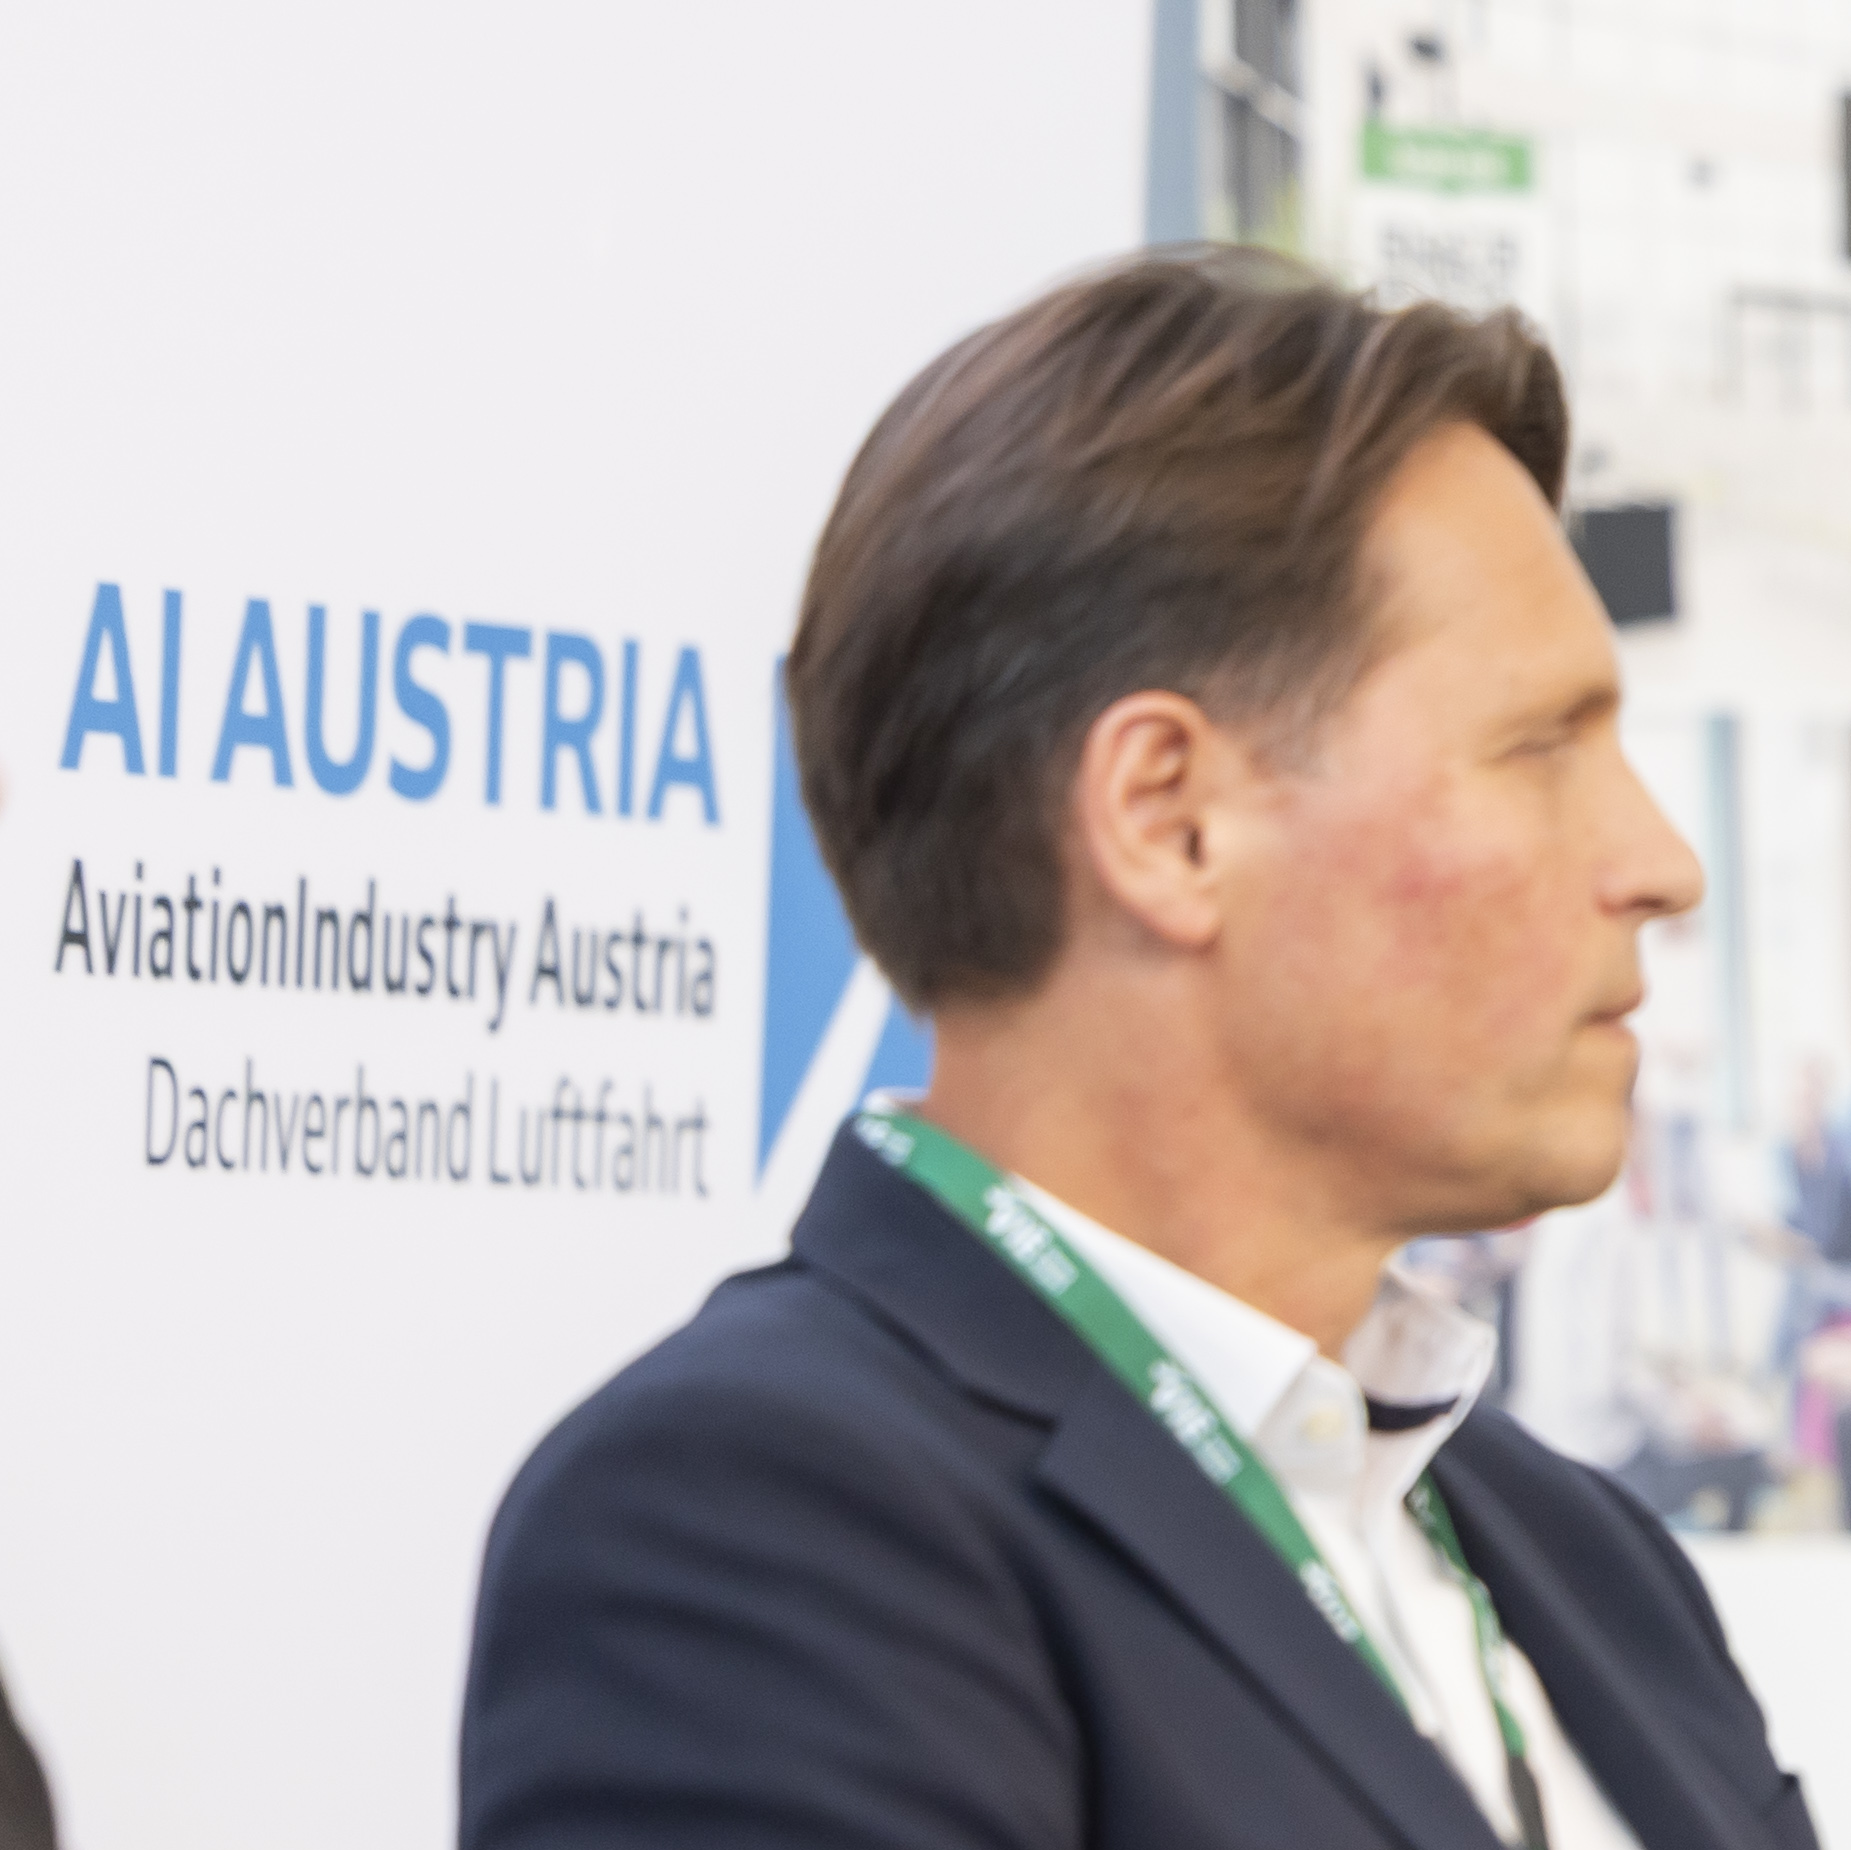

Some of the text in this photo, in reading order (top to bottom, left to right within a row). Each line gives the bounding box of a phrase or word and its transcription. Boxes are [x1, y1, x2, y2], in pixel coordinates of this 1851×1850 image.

[59, 582, 722, 828] AI AUSTRIA
[529, 895, 716, 1019] Austria
[145, 1056, 474, 1184] Dachverband
[489, 1074, 709, 1199] Luftfahrt
